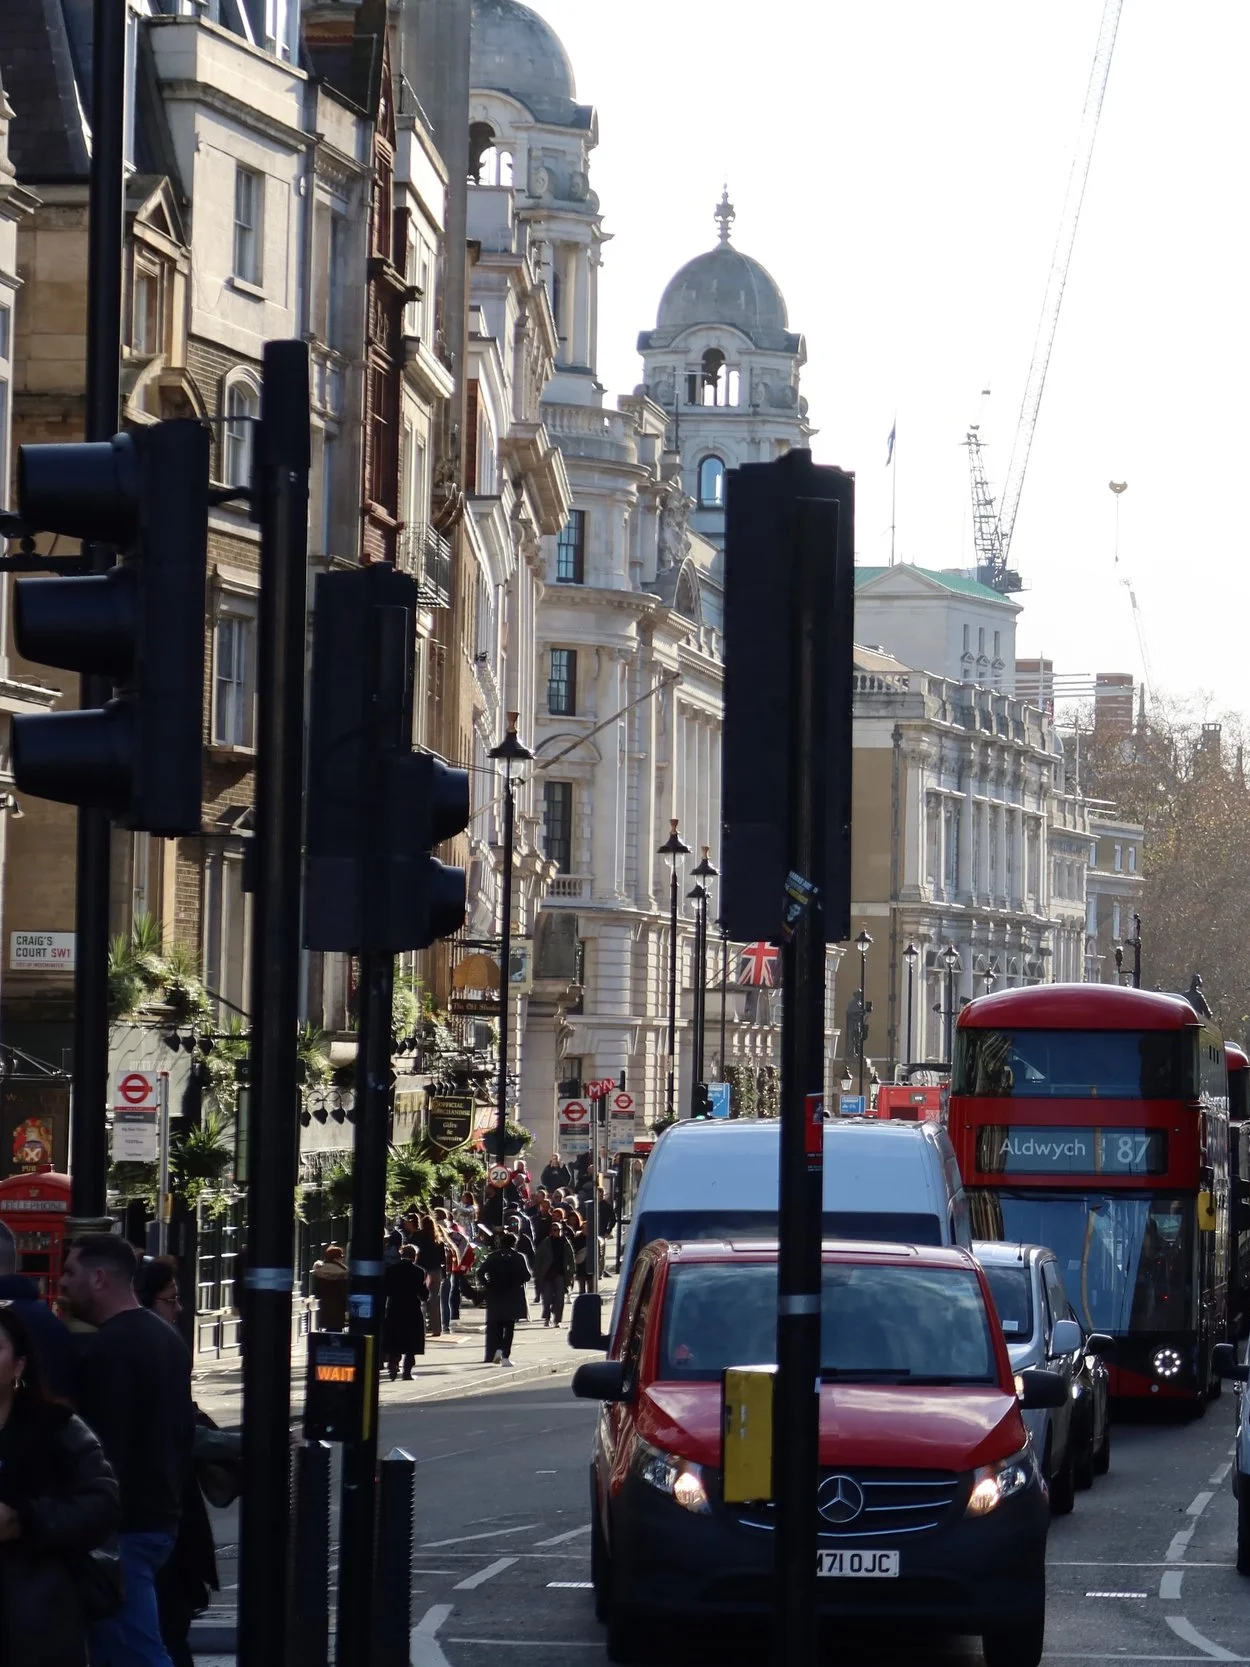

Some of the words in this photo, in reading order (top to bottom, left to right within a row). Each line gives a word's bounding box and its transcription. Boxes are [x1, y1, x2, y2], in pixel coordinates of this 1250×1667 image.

[16, 935, 53, 946] CRAIG'S
[15, 947, 48, 958] COURT
[50, 947, 72, 958] SW1
[589, 1085, 600, 1096] M
[603, 1080, 614, 1090] N
[999, 1137, 1086, 1161] Aldwych
[1116, 1136, 1151, 1164] 87
[492, 1171, 507, 1181] 20
[4, 1201, 66, 1211] TELEPHONE
[317, 1366, 354, 1382] WAIT
[849, 1553, 890, 1573] OJC
